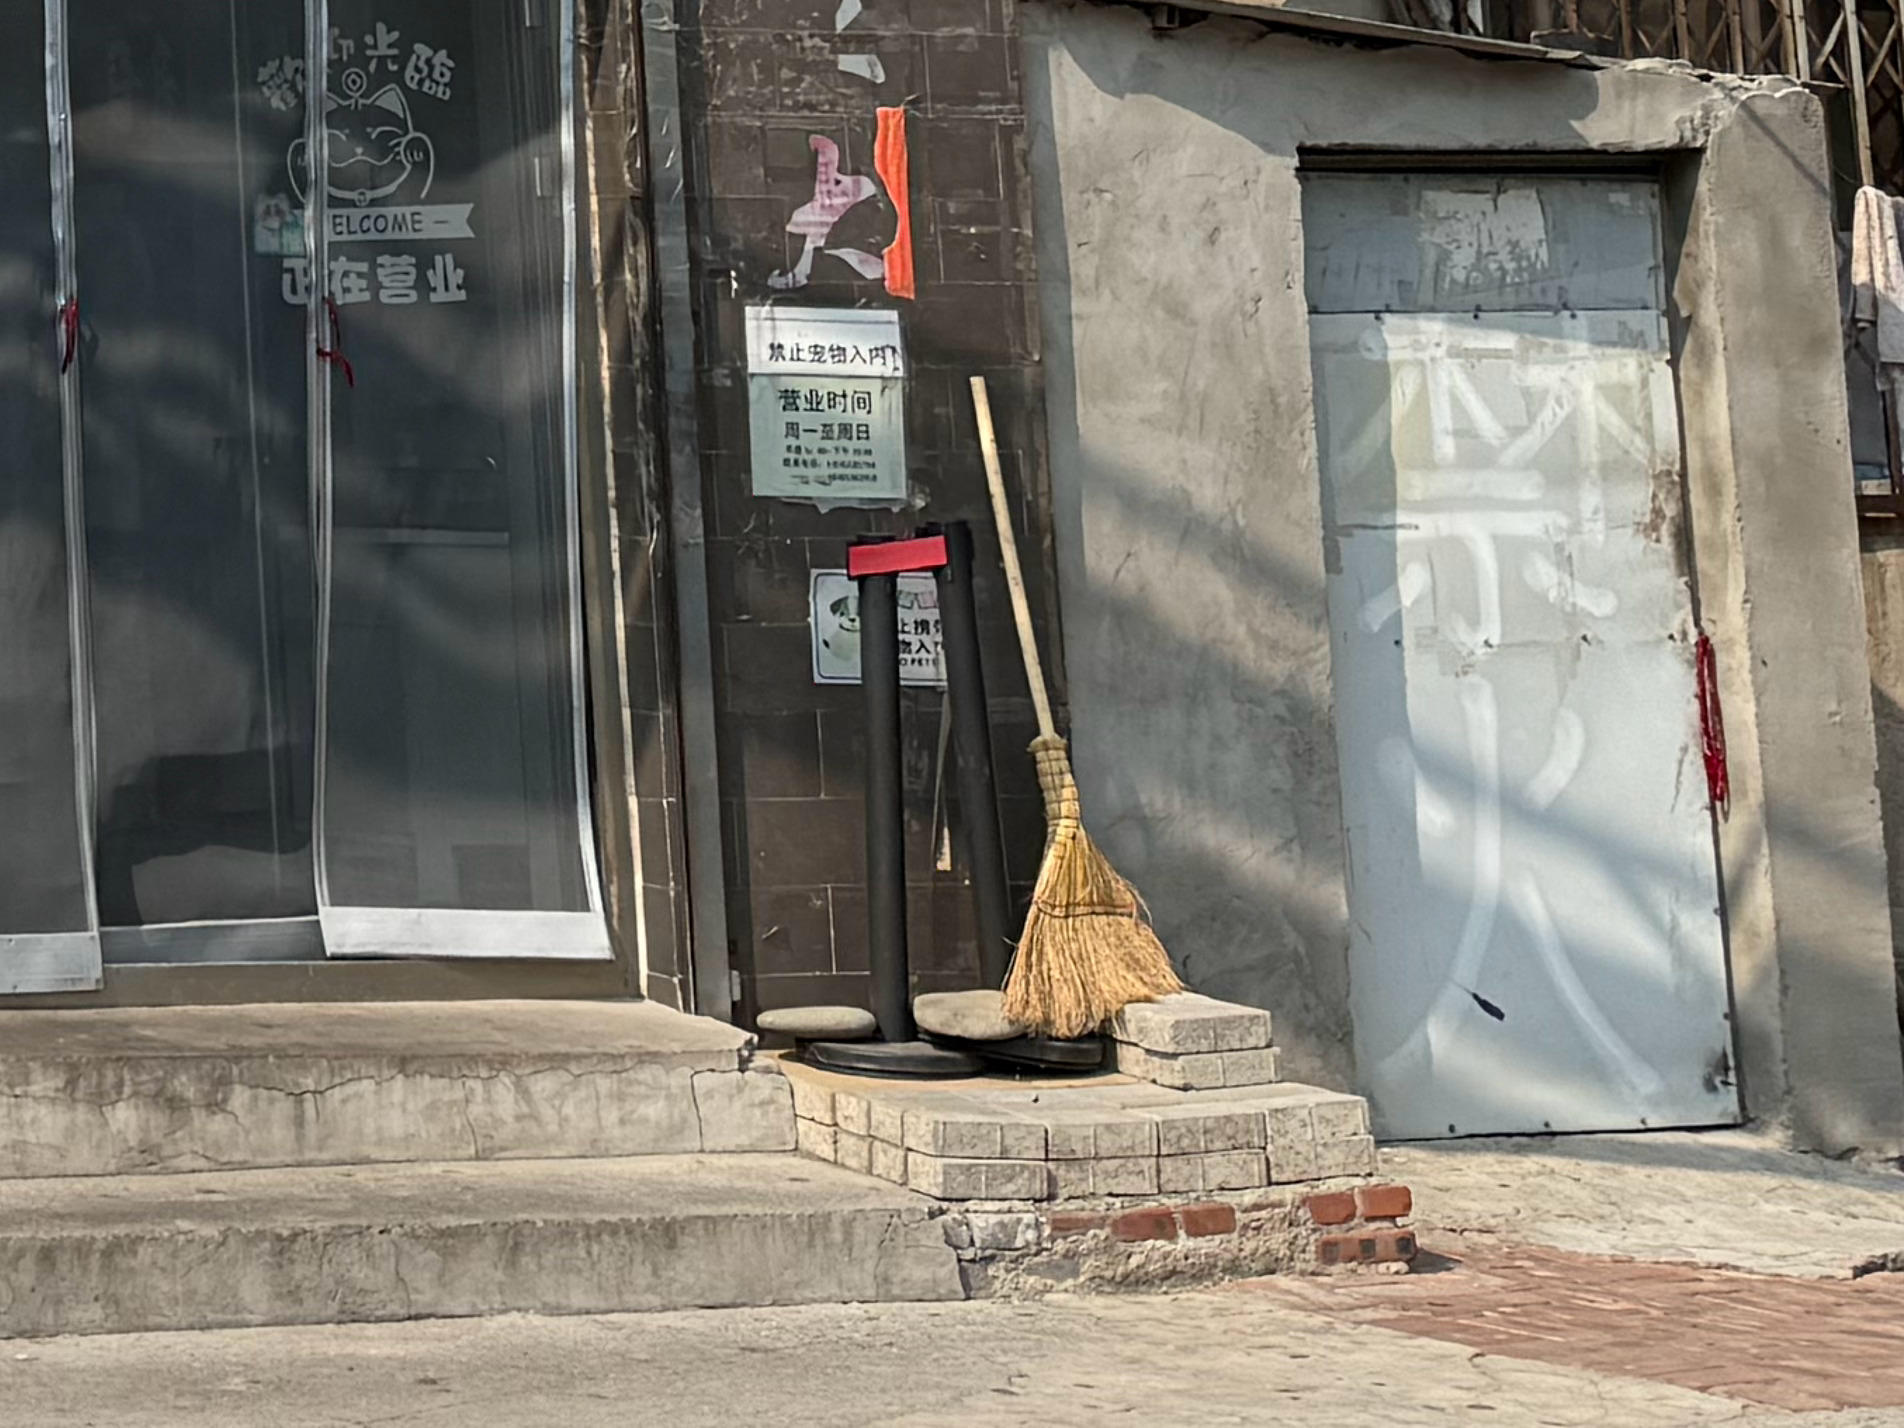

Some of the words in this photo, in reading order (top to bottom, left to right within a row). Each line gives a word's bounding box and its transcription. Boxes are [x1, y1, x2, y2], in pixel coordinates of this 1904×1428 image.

[331, 211, 424, 236] ELCOME
[777, 387, 873, 415] 营业时间
[784, 421, 871, 442] 周一至周日
